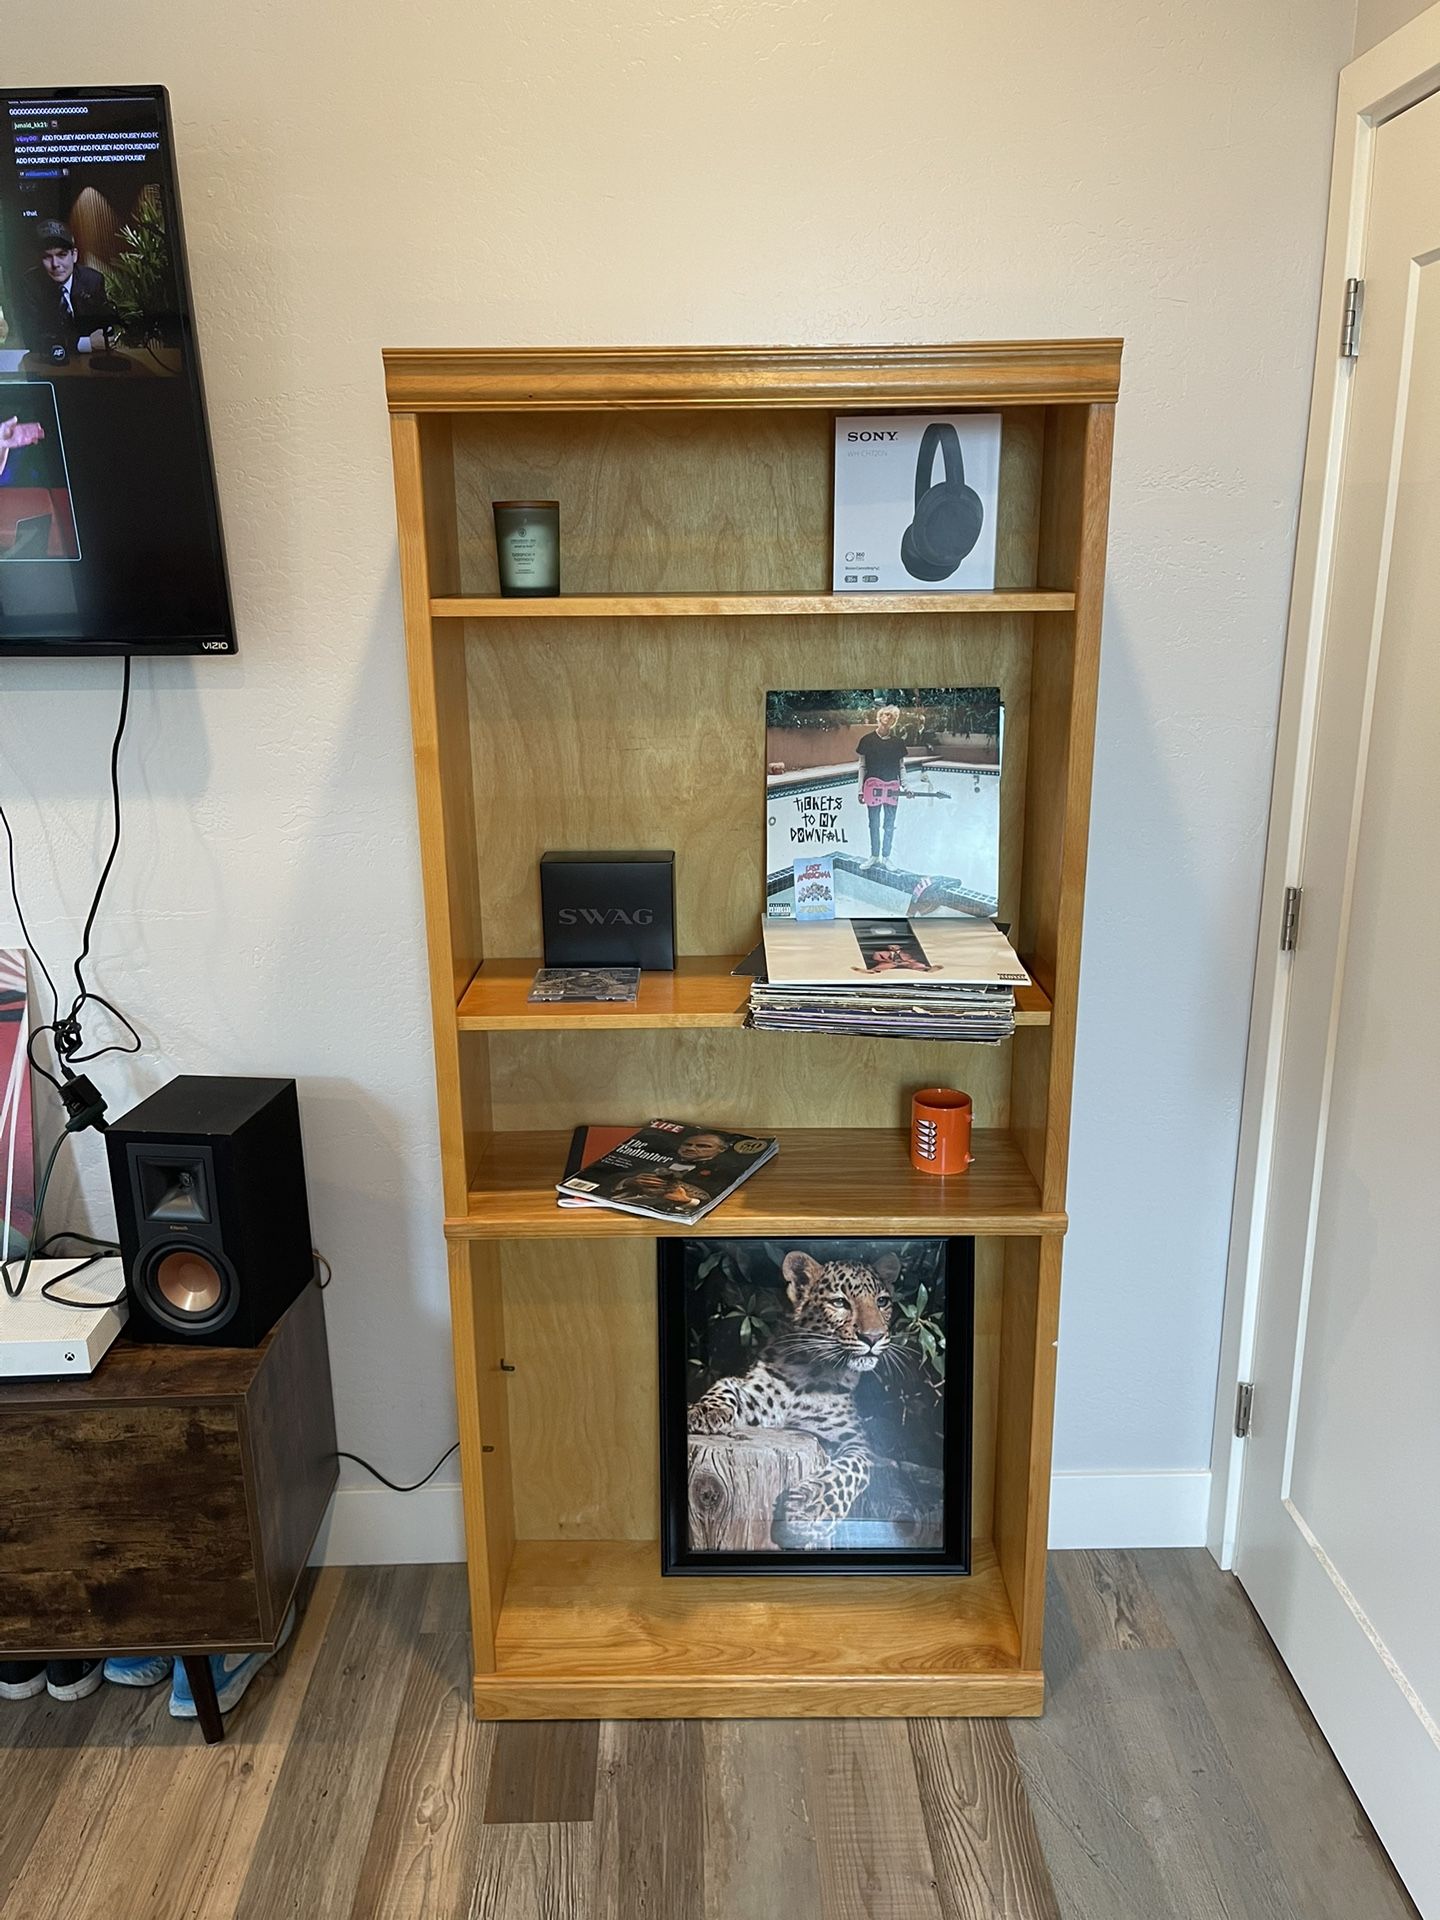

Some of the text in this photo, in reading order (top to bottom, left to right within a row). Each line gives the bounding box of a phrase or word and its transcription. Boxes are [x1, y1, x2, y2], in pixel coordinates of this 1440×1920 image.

[848, 431, 897, 442] SONY
[202, 641, 228, 650] VIZIO
[820, 812, 837, 827] MY
[790, 827, 848, 843] DOWNFALL
[558, 908, 653, 925] SWAG
[650, 1120, 685, 1133] LIFE
[625, 1139, 648, 1149] The
[616, 1145, 674, 1163] Godfather
